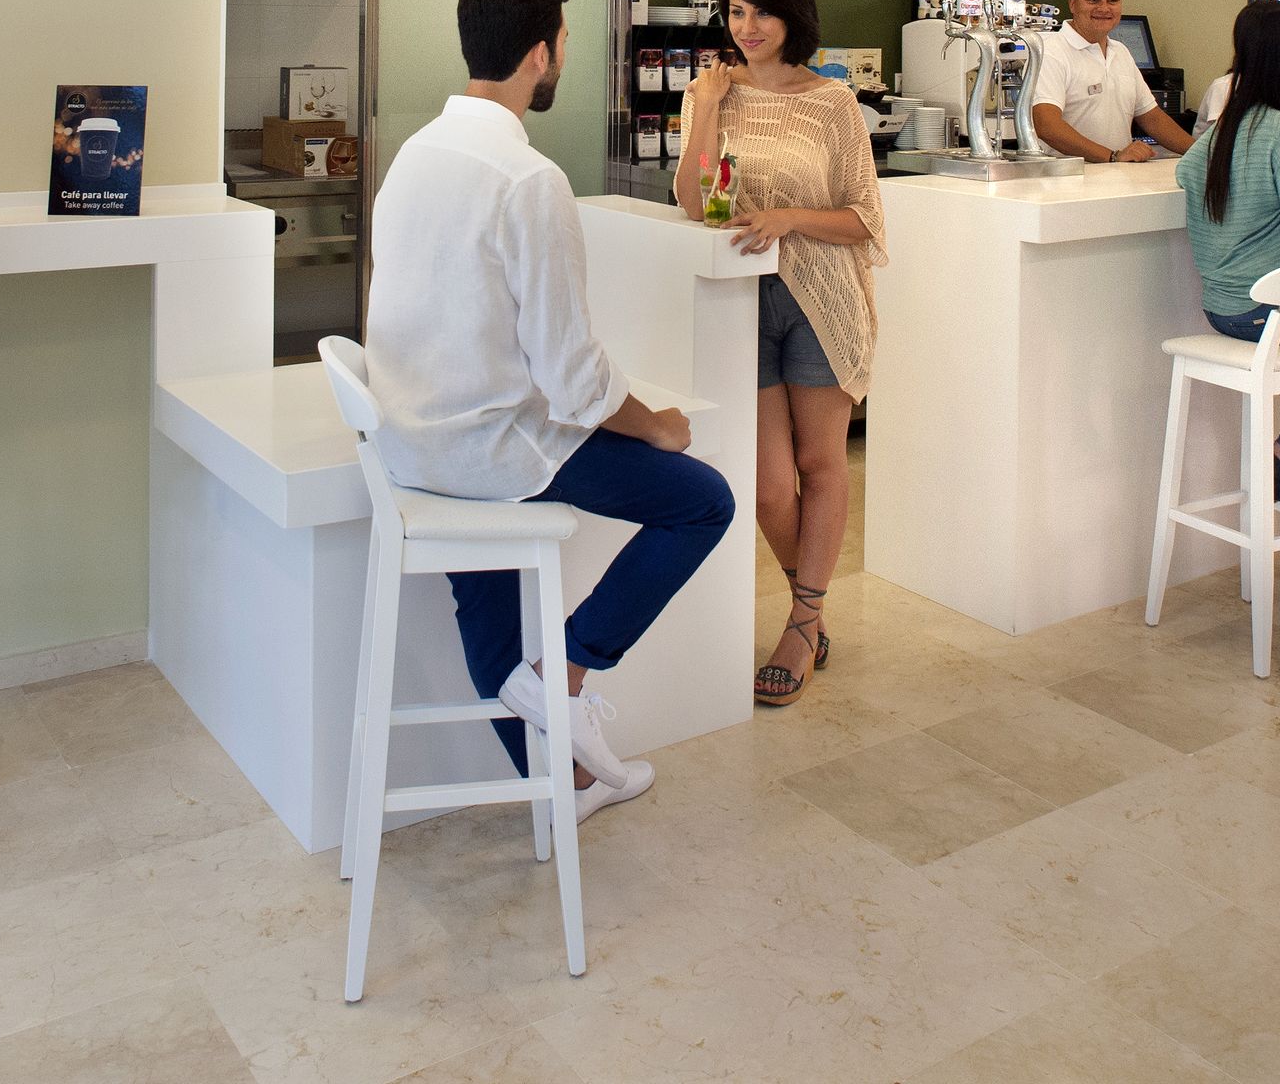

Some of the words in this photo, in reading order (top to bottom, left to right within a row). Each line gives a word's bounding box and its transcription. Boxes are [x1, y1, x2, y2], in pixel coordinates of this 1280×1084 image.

[61, 190, 81, 199] Café
[82, 192, 102, 201] para
[103, 191, 129, 199] llevar
[64, 201, 81, 209] Take
[82, 202, 101, 210] away
[102, 201, 124, 209] coffee
